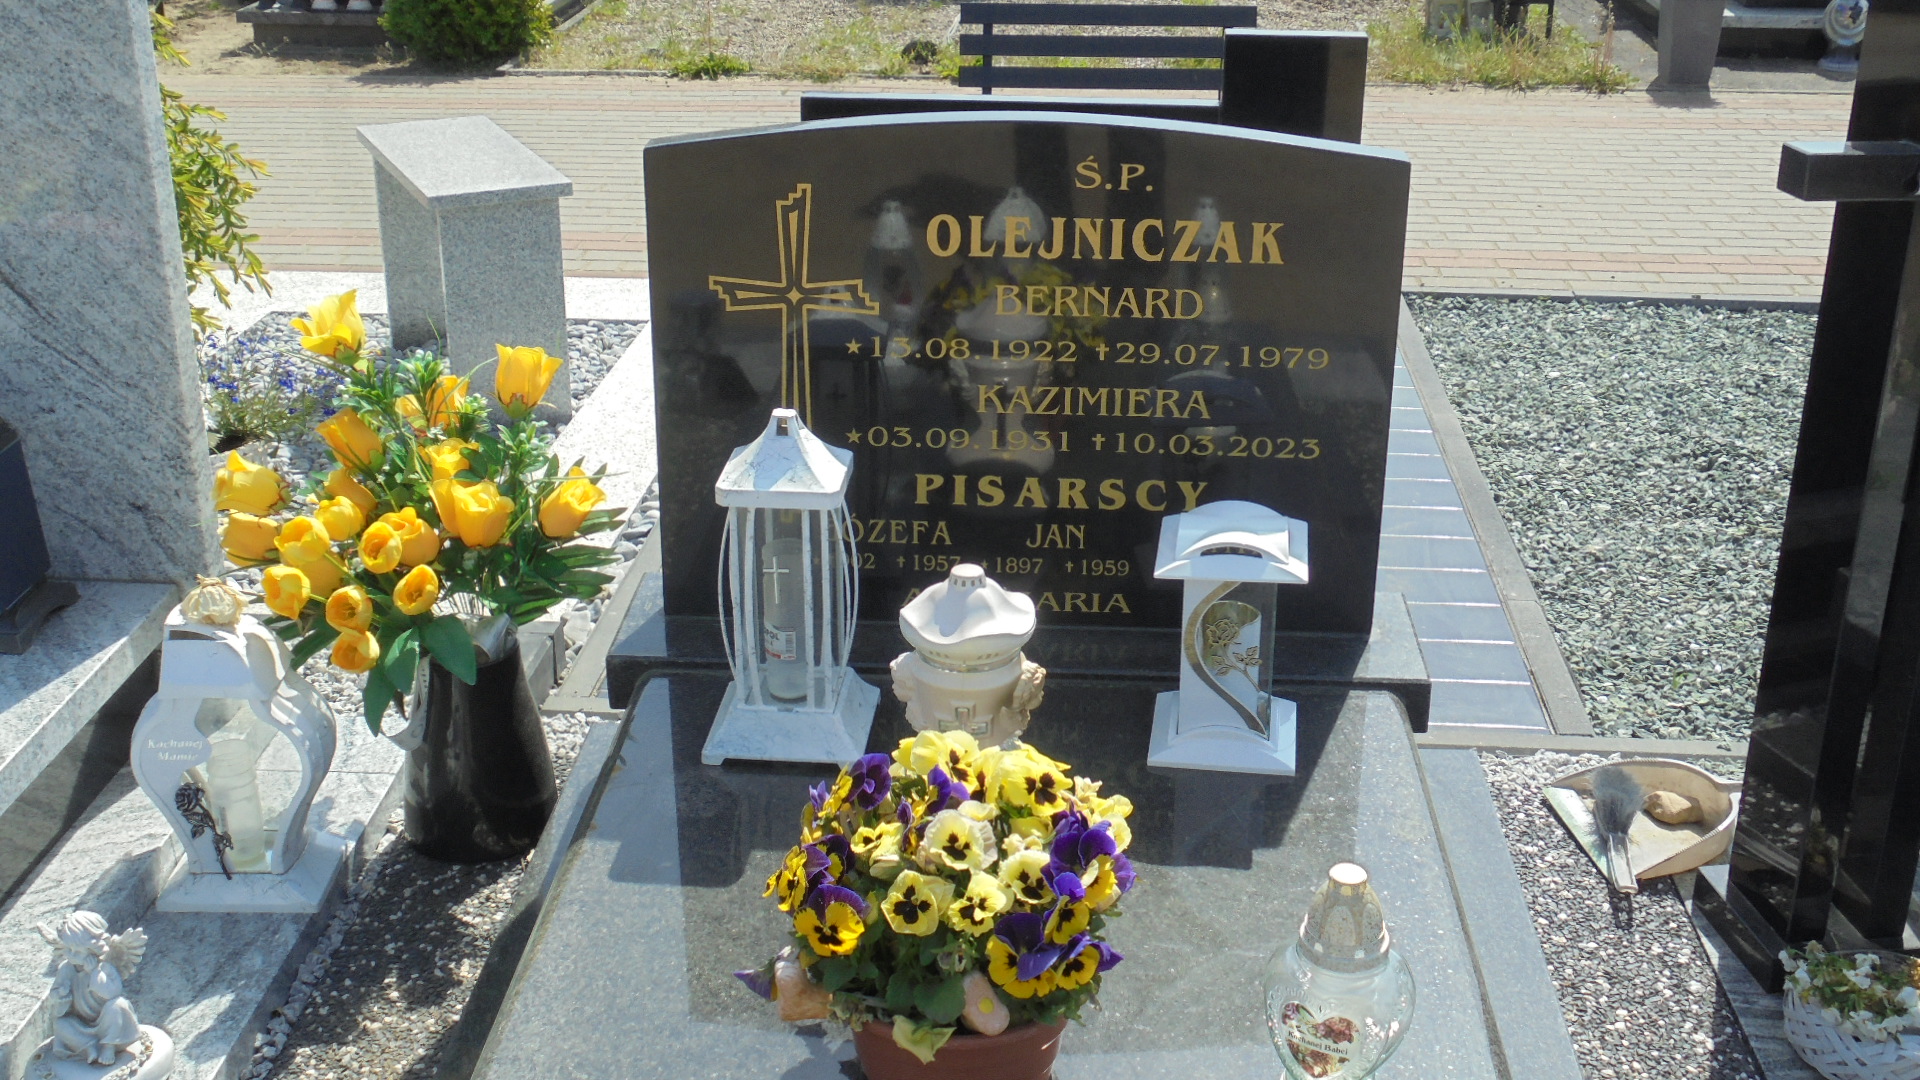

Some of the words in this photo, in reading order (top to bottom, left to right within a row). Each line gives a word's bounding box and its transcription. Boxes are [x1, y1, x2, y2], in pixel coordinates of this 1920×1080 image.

[1074, 155, 1154, 192] Ś.P.
[925, 213, 1285, 266] OLEJNICZAK
[995, 284, 1204, 321] BERNARD
[868, 336, 1078, 364] 13.08.1922
[1115, 341, 1331, 370] 29.07.1979
[976, 383, 1212, 420] KAZIMIERA
[867, 426, 1071, 453] 03.09.1931
[1117, 432, 1321, 460] 10.03.2023
[915, 473, 1208, 512] PISARSCY
[1025, 523, 1086, 550] JAN
[995, 557, 1044, 574] 1897
[1081, 559, 1130, 576] 1959
[1023, 591, 1133, 613] ARIA
